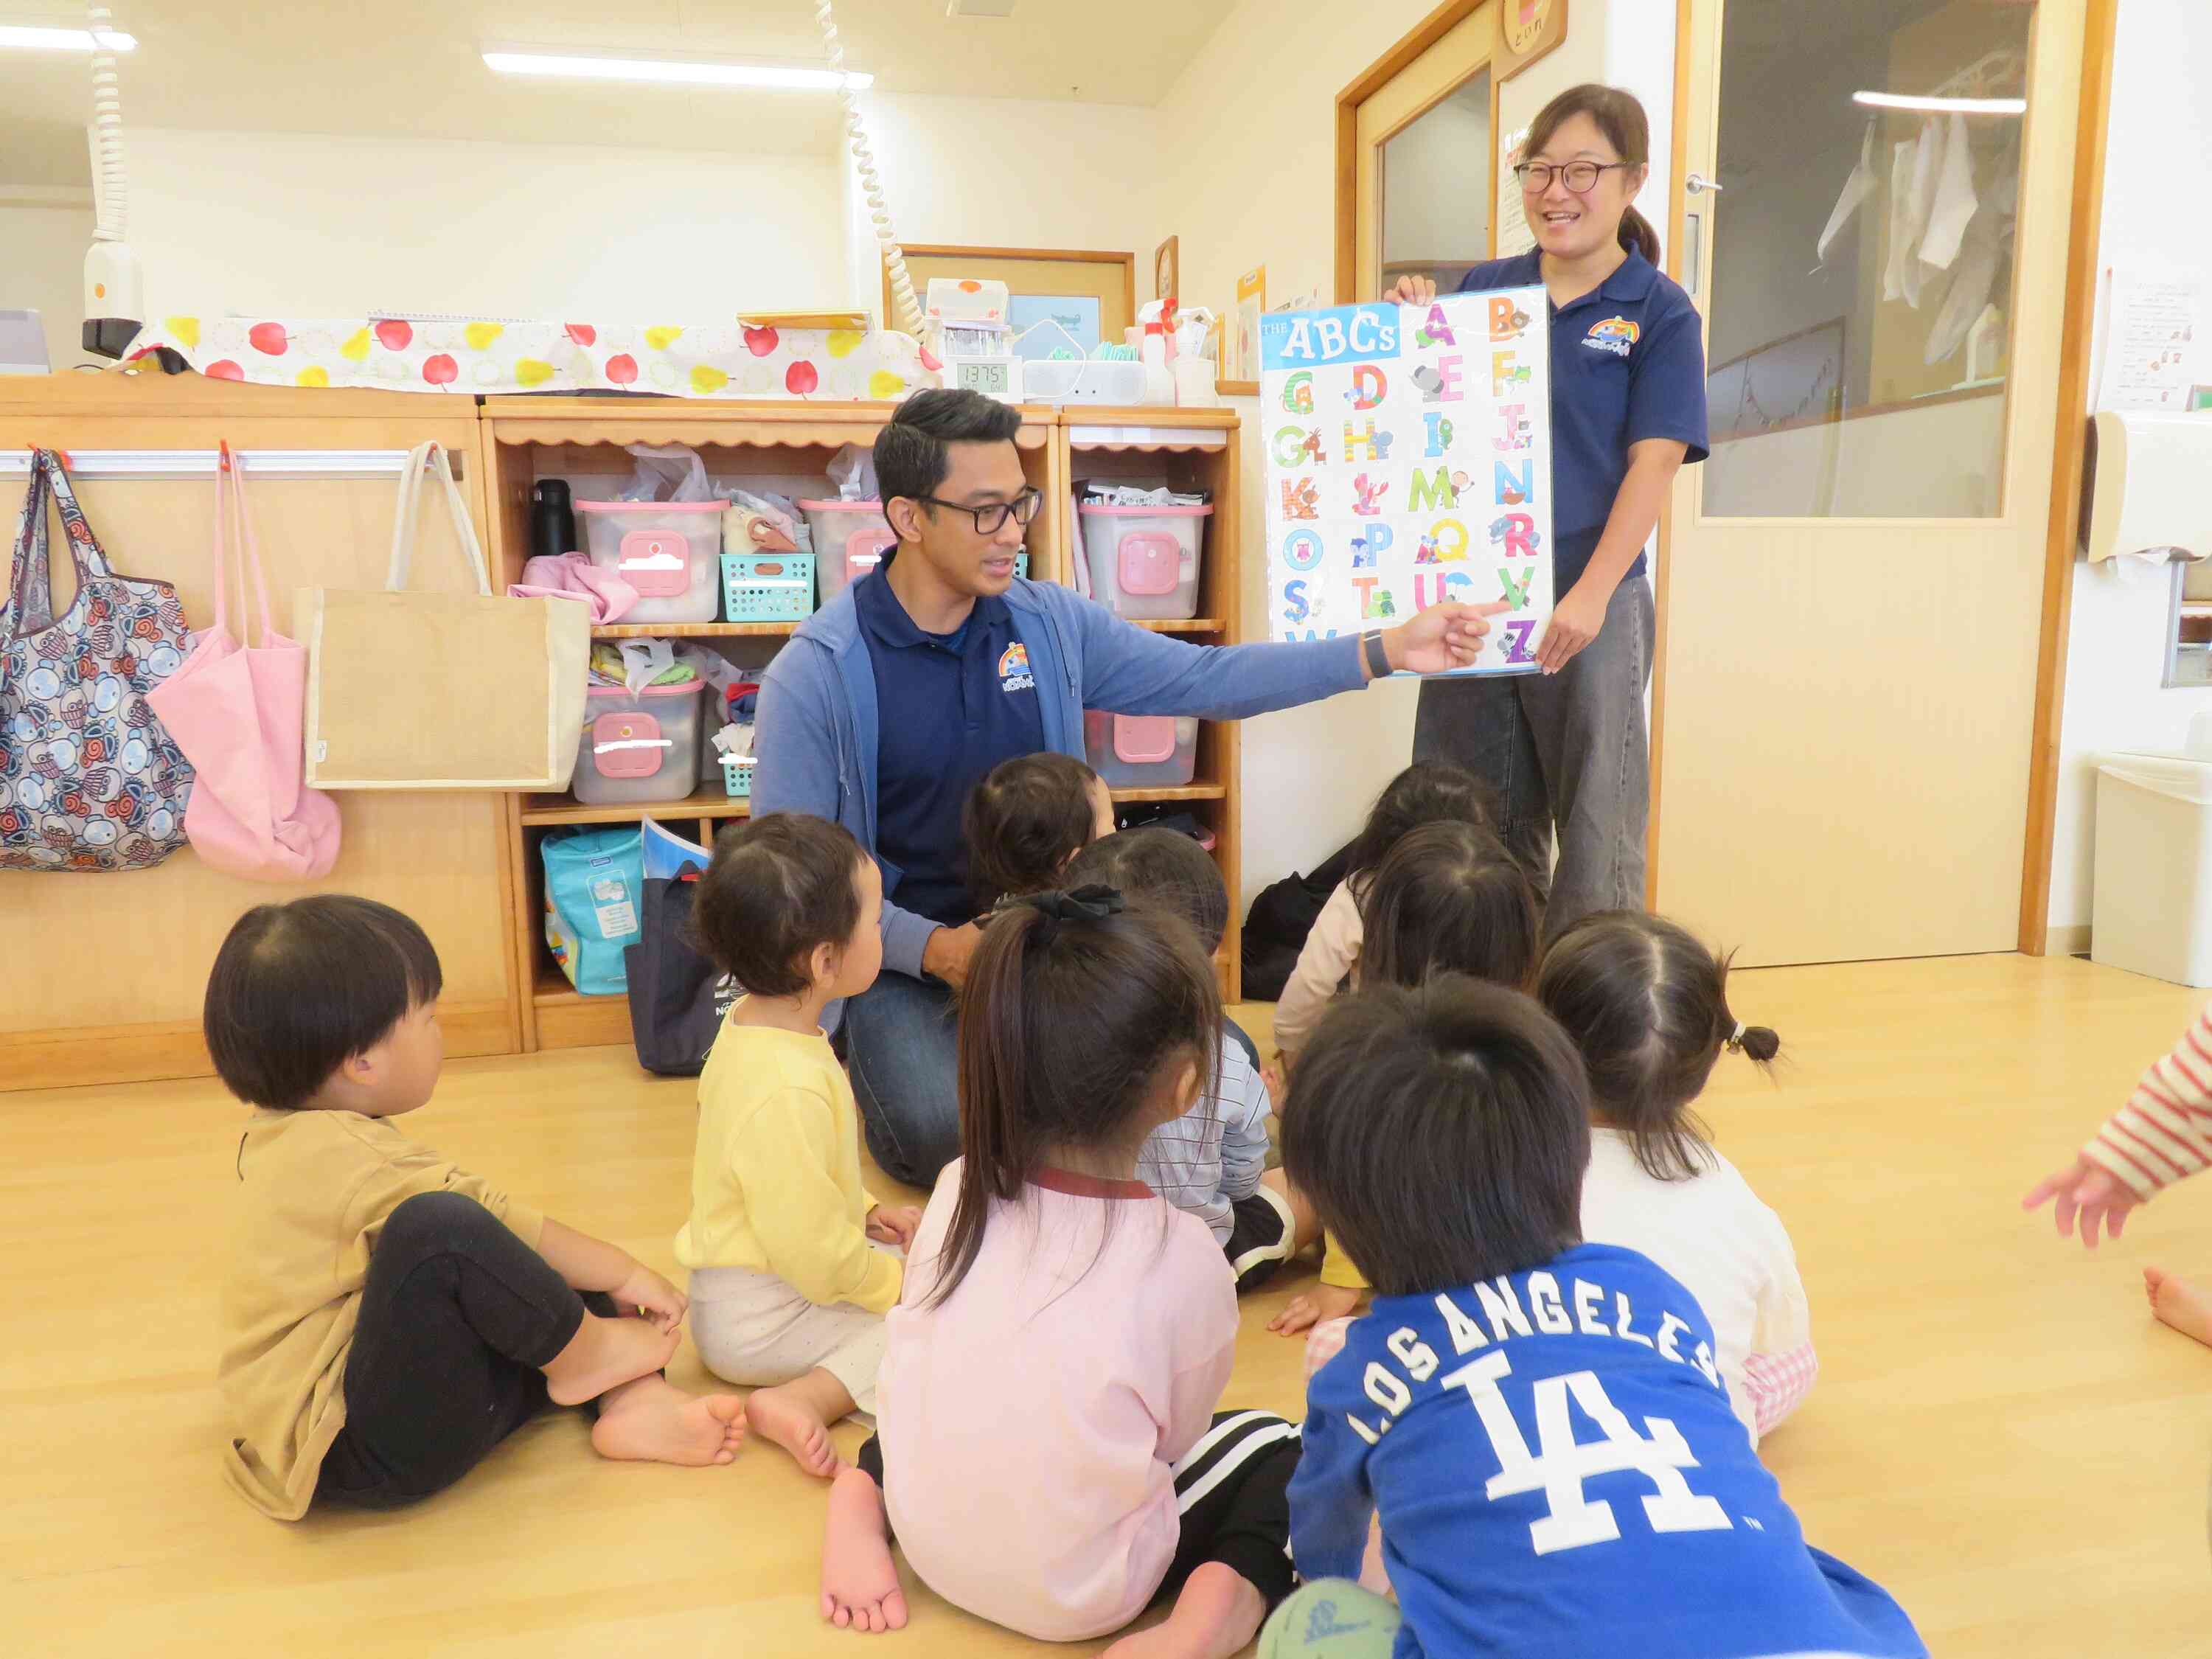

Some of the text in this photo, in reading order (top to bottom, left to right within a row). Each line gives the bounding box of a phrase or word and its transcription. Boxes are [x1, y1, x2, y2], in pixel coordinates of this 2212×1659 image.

[1262, 307, 1396, 360] THE ABCs
[1417, 297, 1520, 349] A B
[1283, 350, 1517, 414] C D E F
[1272, 404, 1526, 467] G H I J
[1281, 477, 1319, 520] K
[1408, 465, 1455, 512] M
[1494, 459, 1534, 506] N
[1283, 513, 1538, 571] O P Q R
[1284, 580, 1310, 623] S
[1352, 577, 1380, 619] T
[1498, 567, 1535, 611] V
[1506, 619, 1537, 664] Z
[1346, 1271, 1721, 1446] LOS ANGELES
[1440, 1349, 1734, 1557] LA
